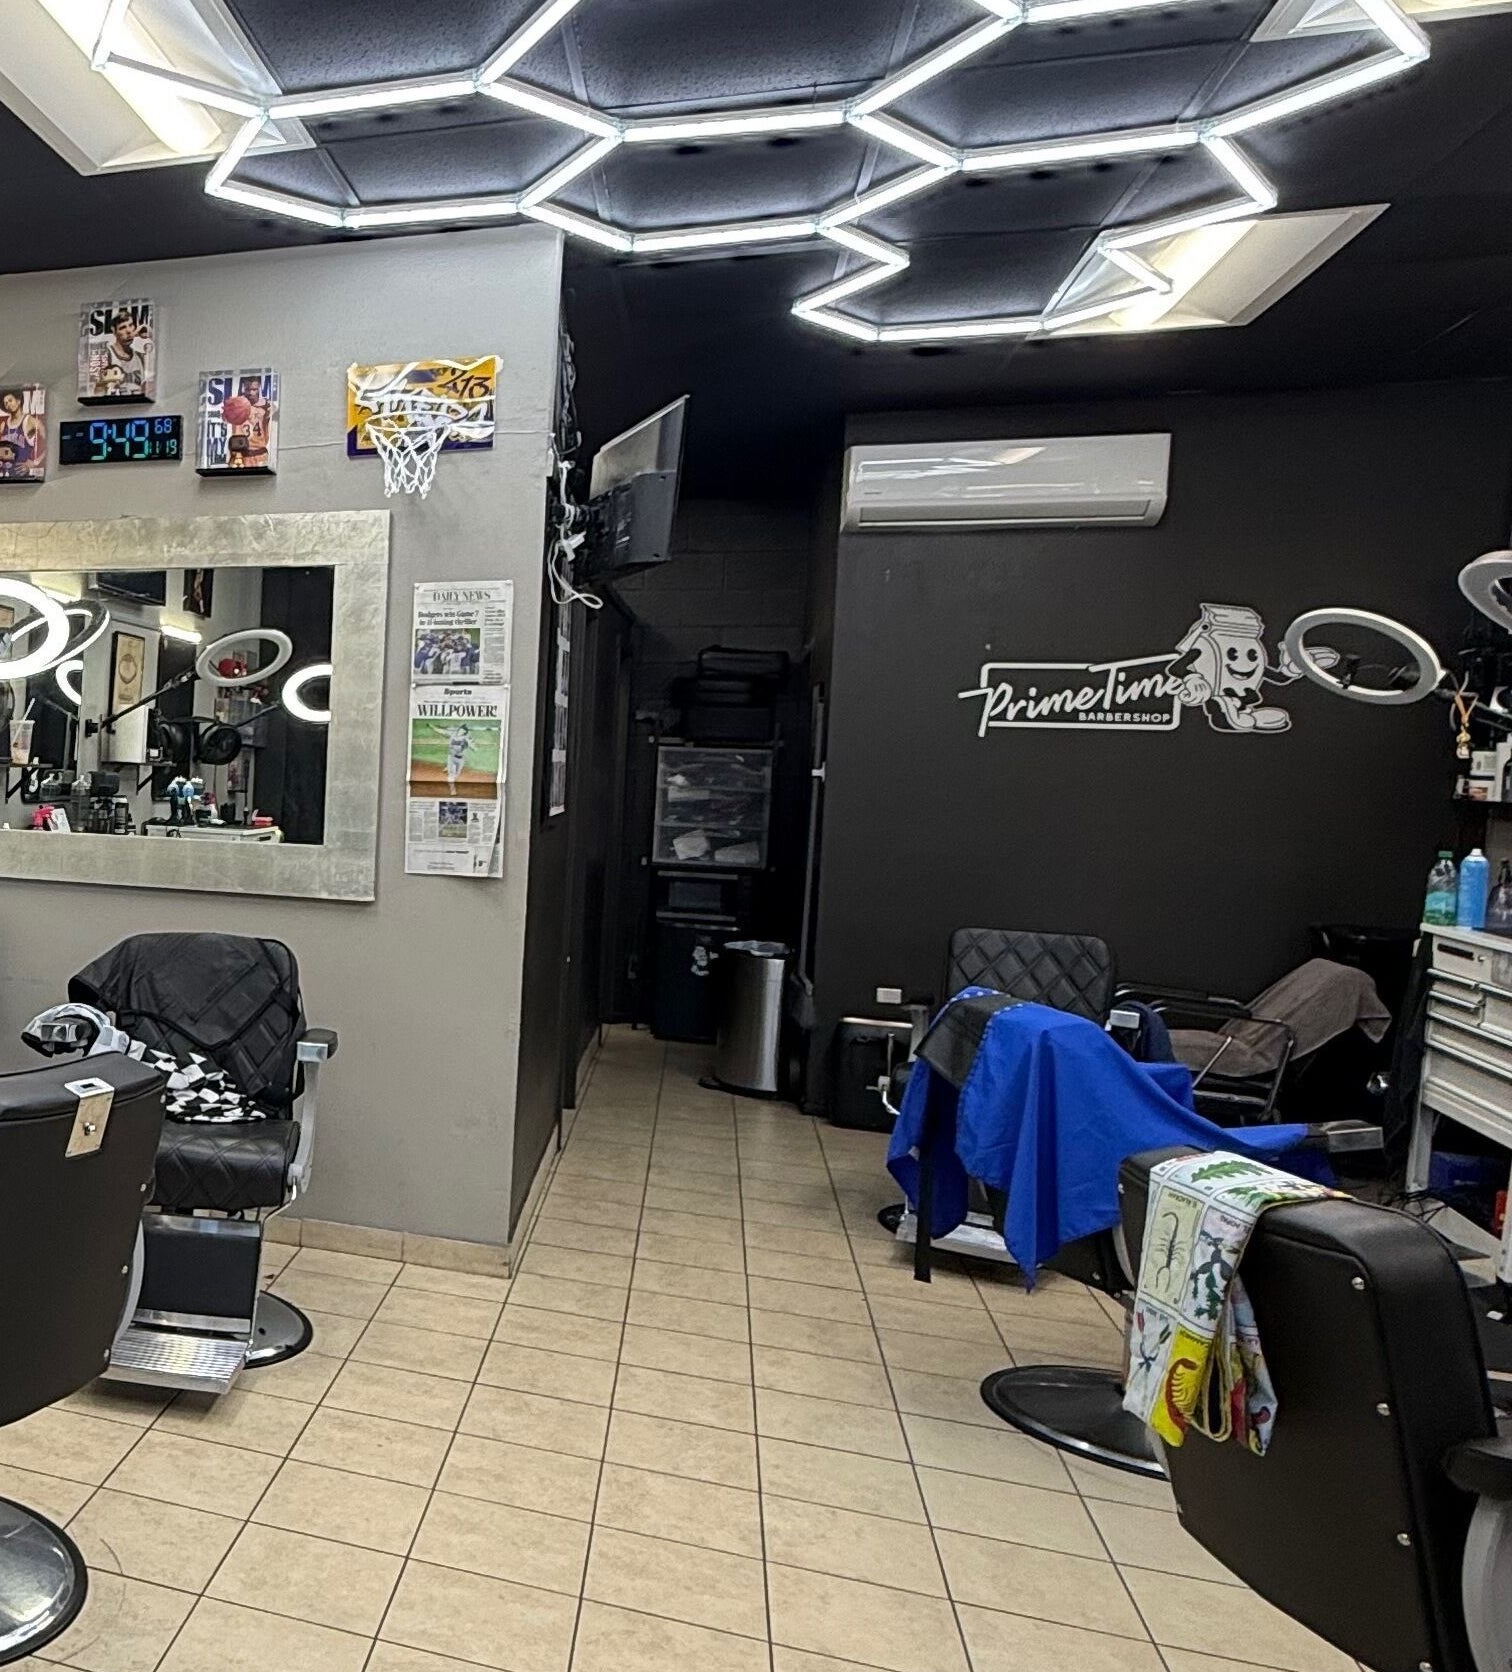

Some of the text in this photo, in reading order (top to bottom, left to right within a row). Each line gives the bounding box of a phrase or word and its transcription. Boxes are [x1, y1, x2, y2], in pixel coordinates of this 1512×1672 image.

[90, 305, 150, 336] SLM
[154, 418, 172, 434] 68
[243, 422, 261, 438] 34
[89, 420, 149, 460] 9:49
[433, 591, 491, 601] DAILY NEWS
[444, 688, 472, 696] Sports
[417, 704, 498, 718] WILLPOWER!
[1078, 712, 1171, 723] BARBERSHOP
